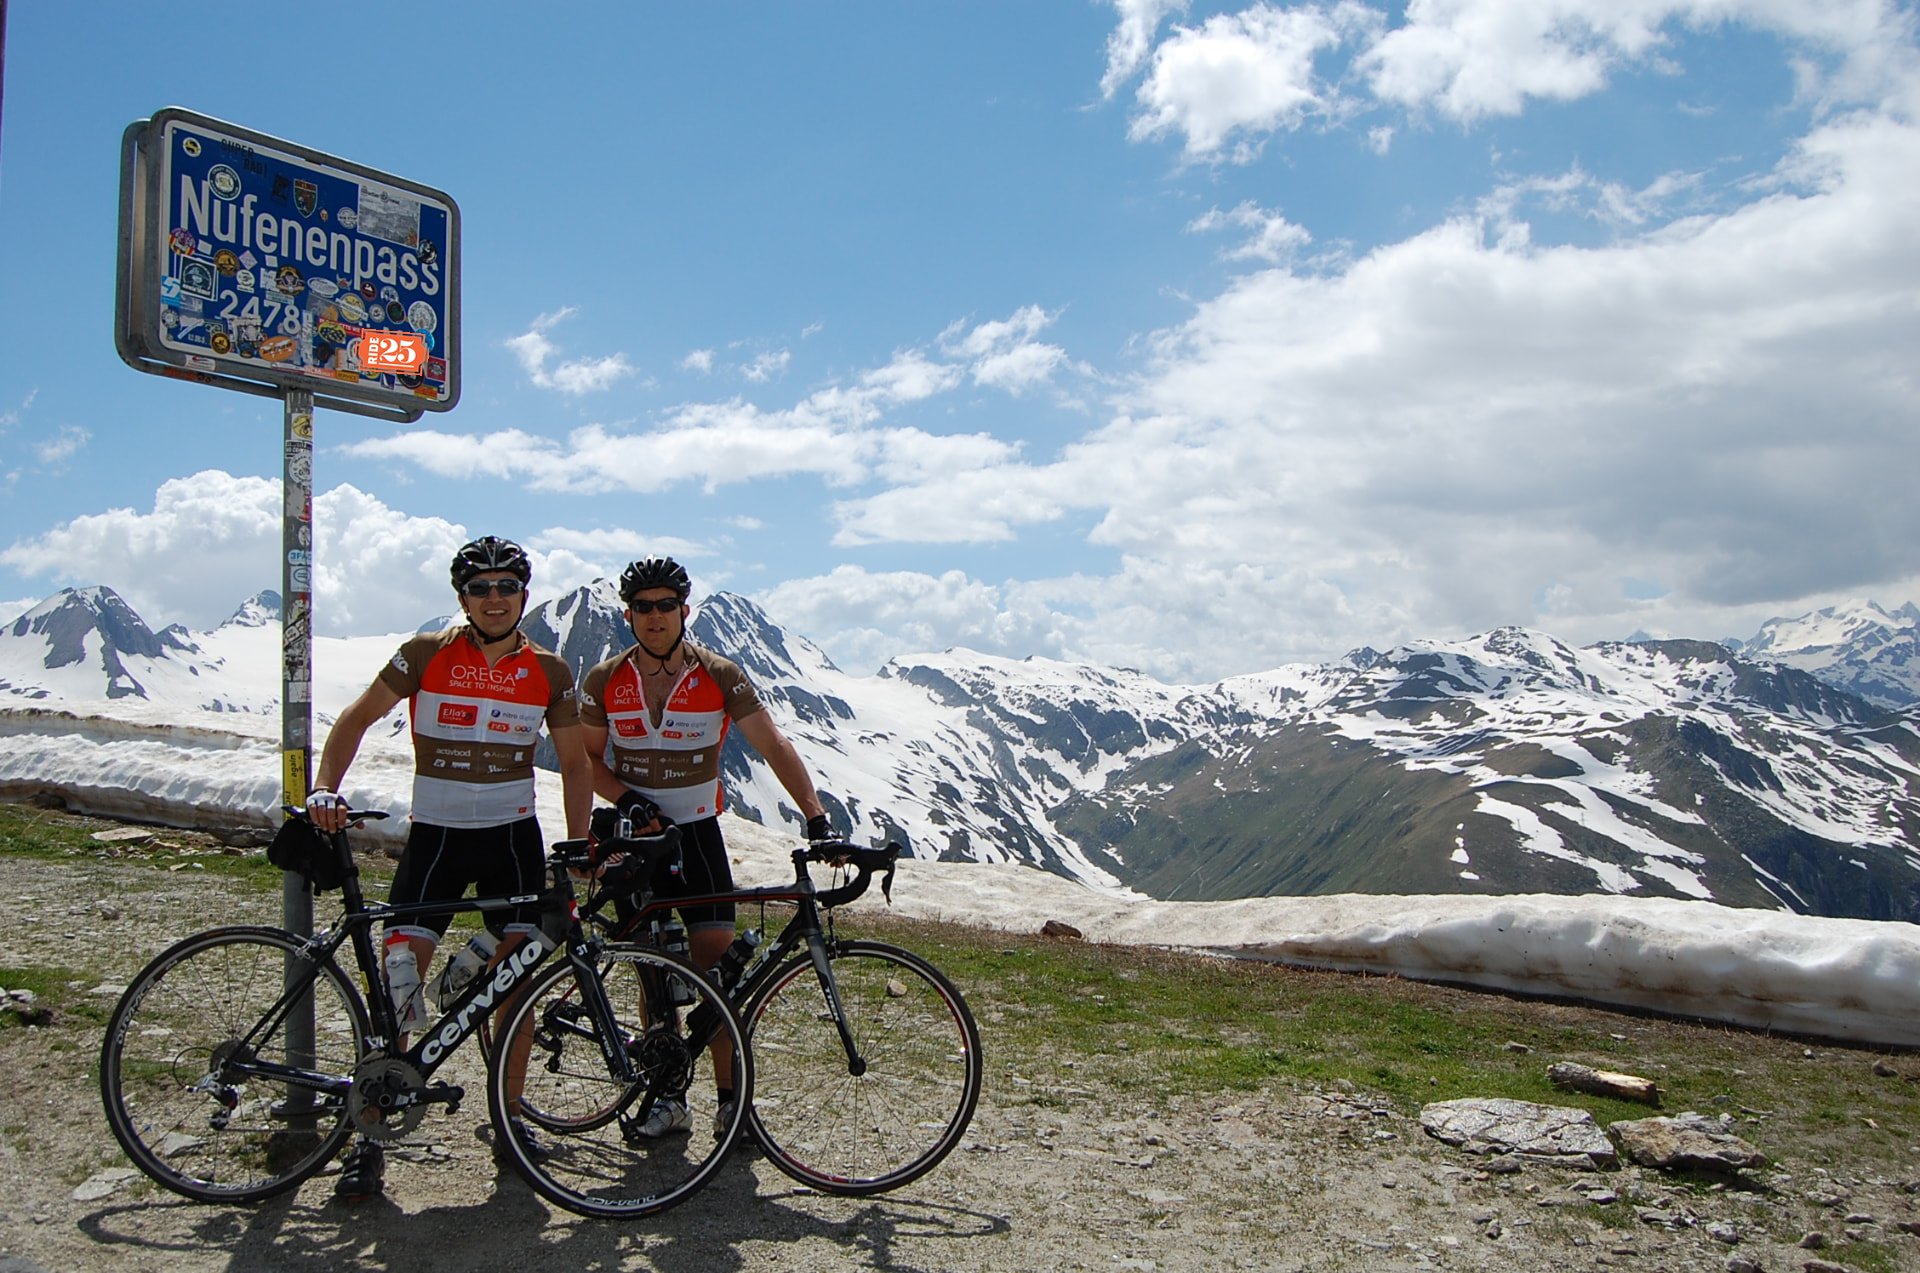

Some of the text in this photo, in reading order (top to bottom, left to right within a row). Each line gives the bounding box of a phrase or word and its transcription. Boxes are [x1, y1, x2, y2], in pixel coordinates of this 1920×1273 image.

[219, 289, 301, 335] 2478
[448, 679, 516, 695] SPACE TO INSPIRE
[451, 664, 516, 687] OREGA
[442, 707, 467, 718] Ella's
[420, 939, 543, 1065] cervélo
